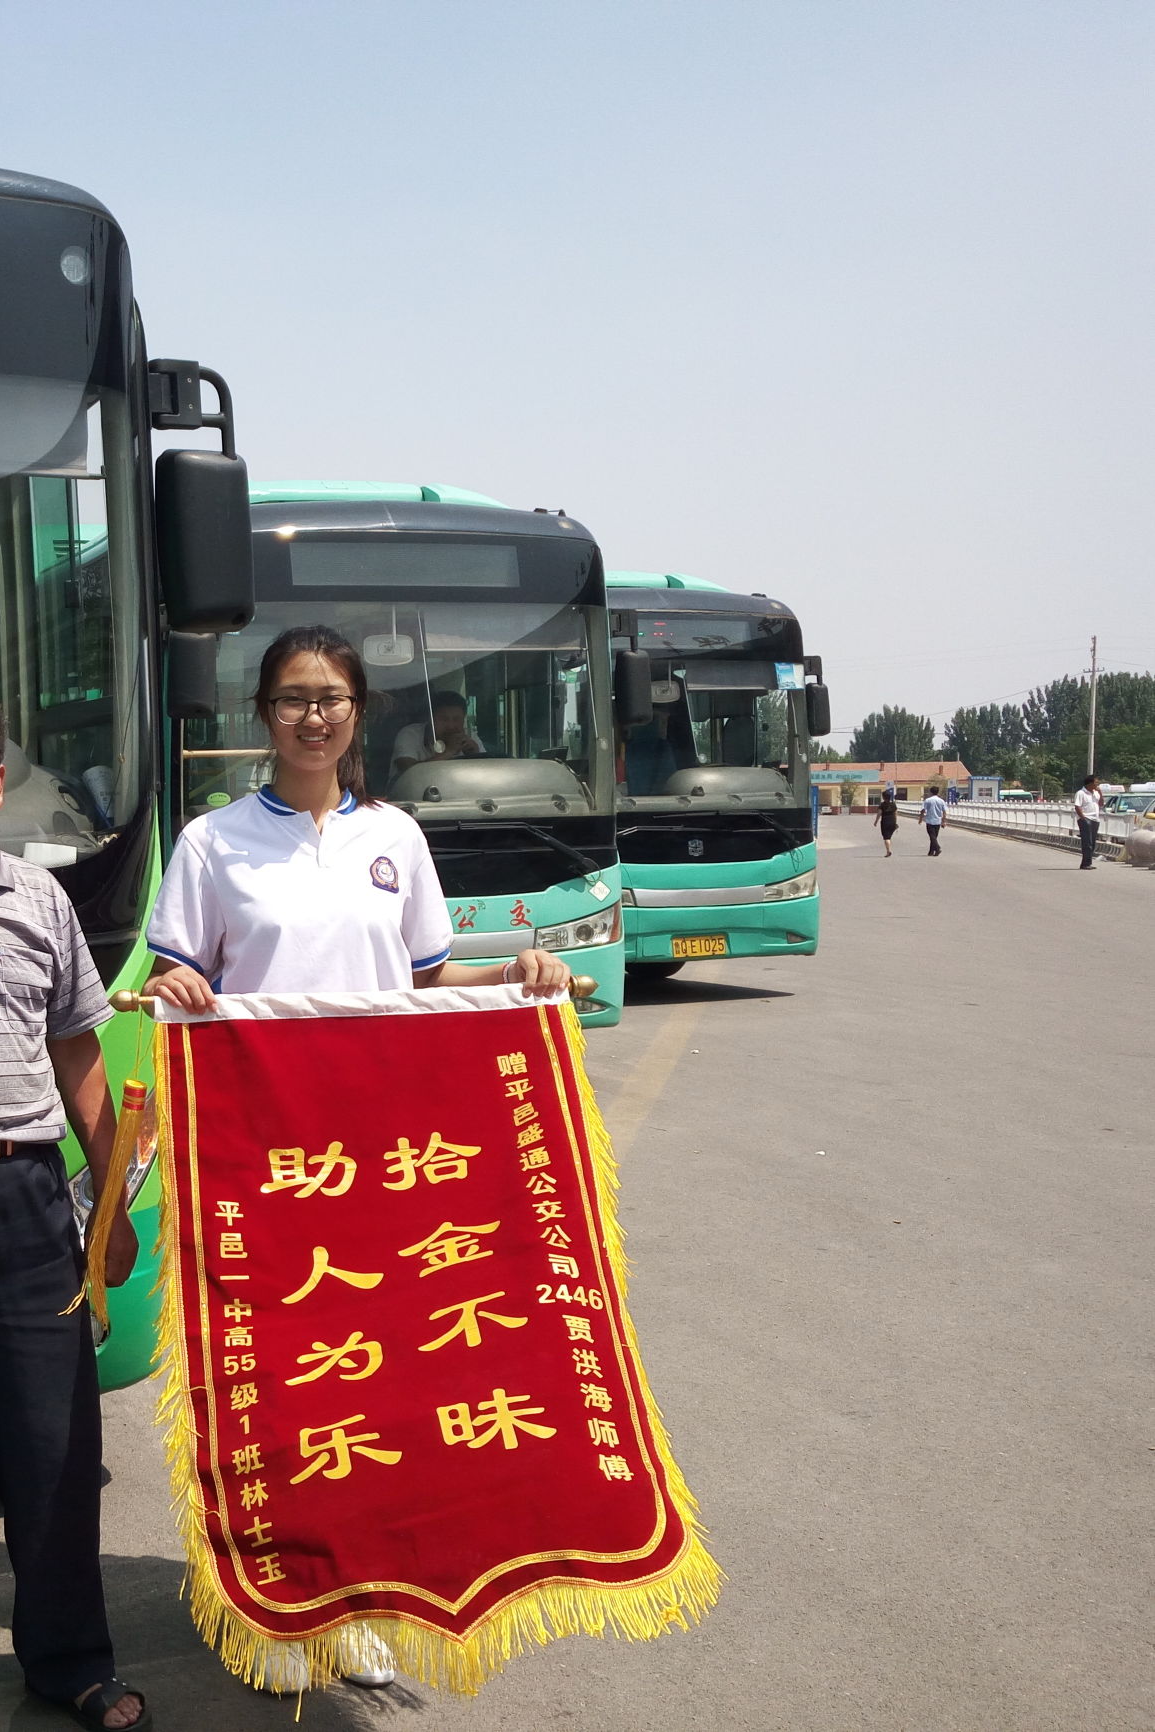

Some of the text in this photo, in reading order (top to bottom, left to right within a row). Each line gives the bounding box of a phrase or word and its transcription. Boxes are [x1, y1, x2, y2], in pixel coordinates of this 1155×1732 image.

[452, 899, 534, 930] 公交
[259, 1140, 403, 1485] 助人为乐
[383, 1131, 557, 1450] 拾金不昧
